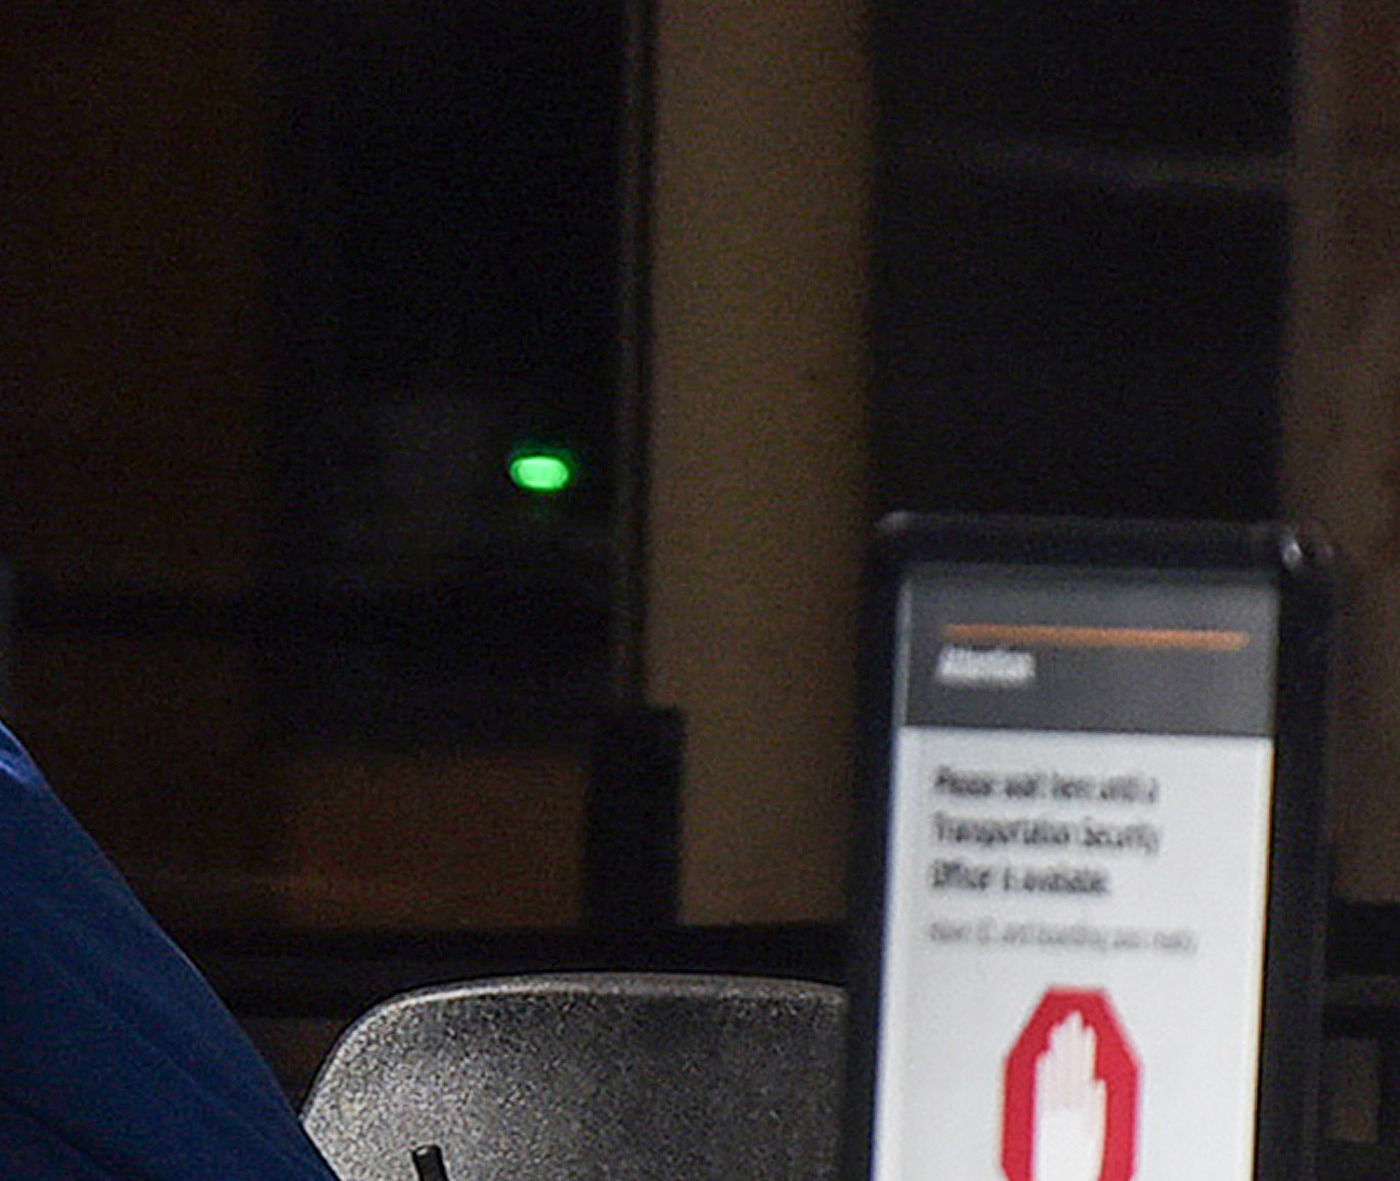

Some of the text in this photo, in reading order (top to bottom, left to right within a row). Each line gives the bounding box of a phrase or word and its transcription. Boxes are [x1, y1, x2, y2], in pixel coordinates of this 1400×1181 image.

[935, 765, 993, 797] Please
[1003, 769, 1043, 798] wait
[934, 811, 1071, 847] Transportation
[931, 859, 991, 892] Officer
